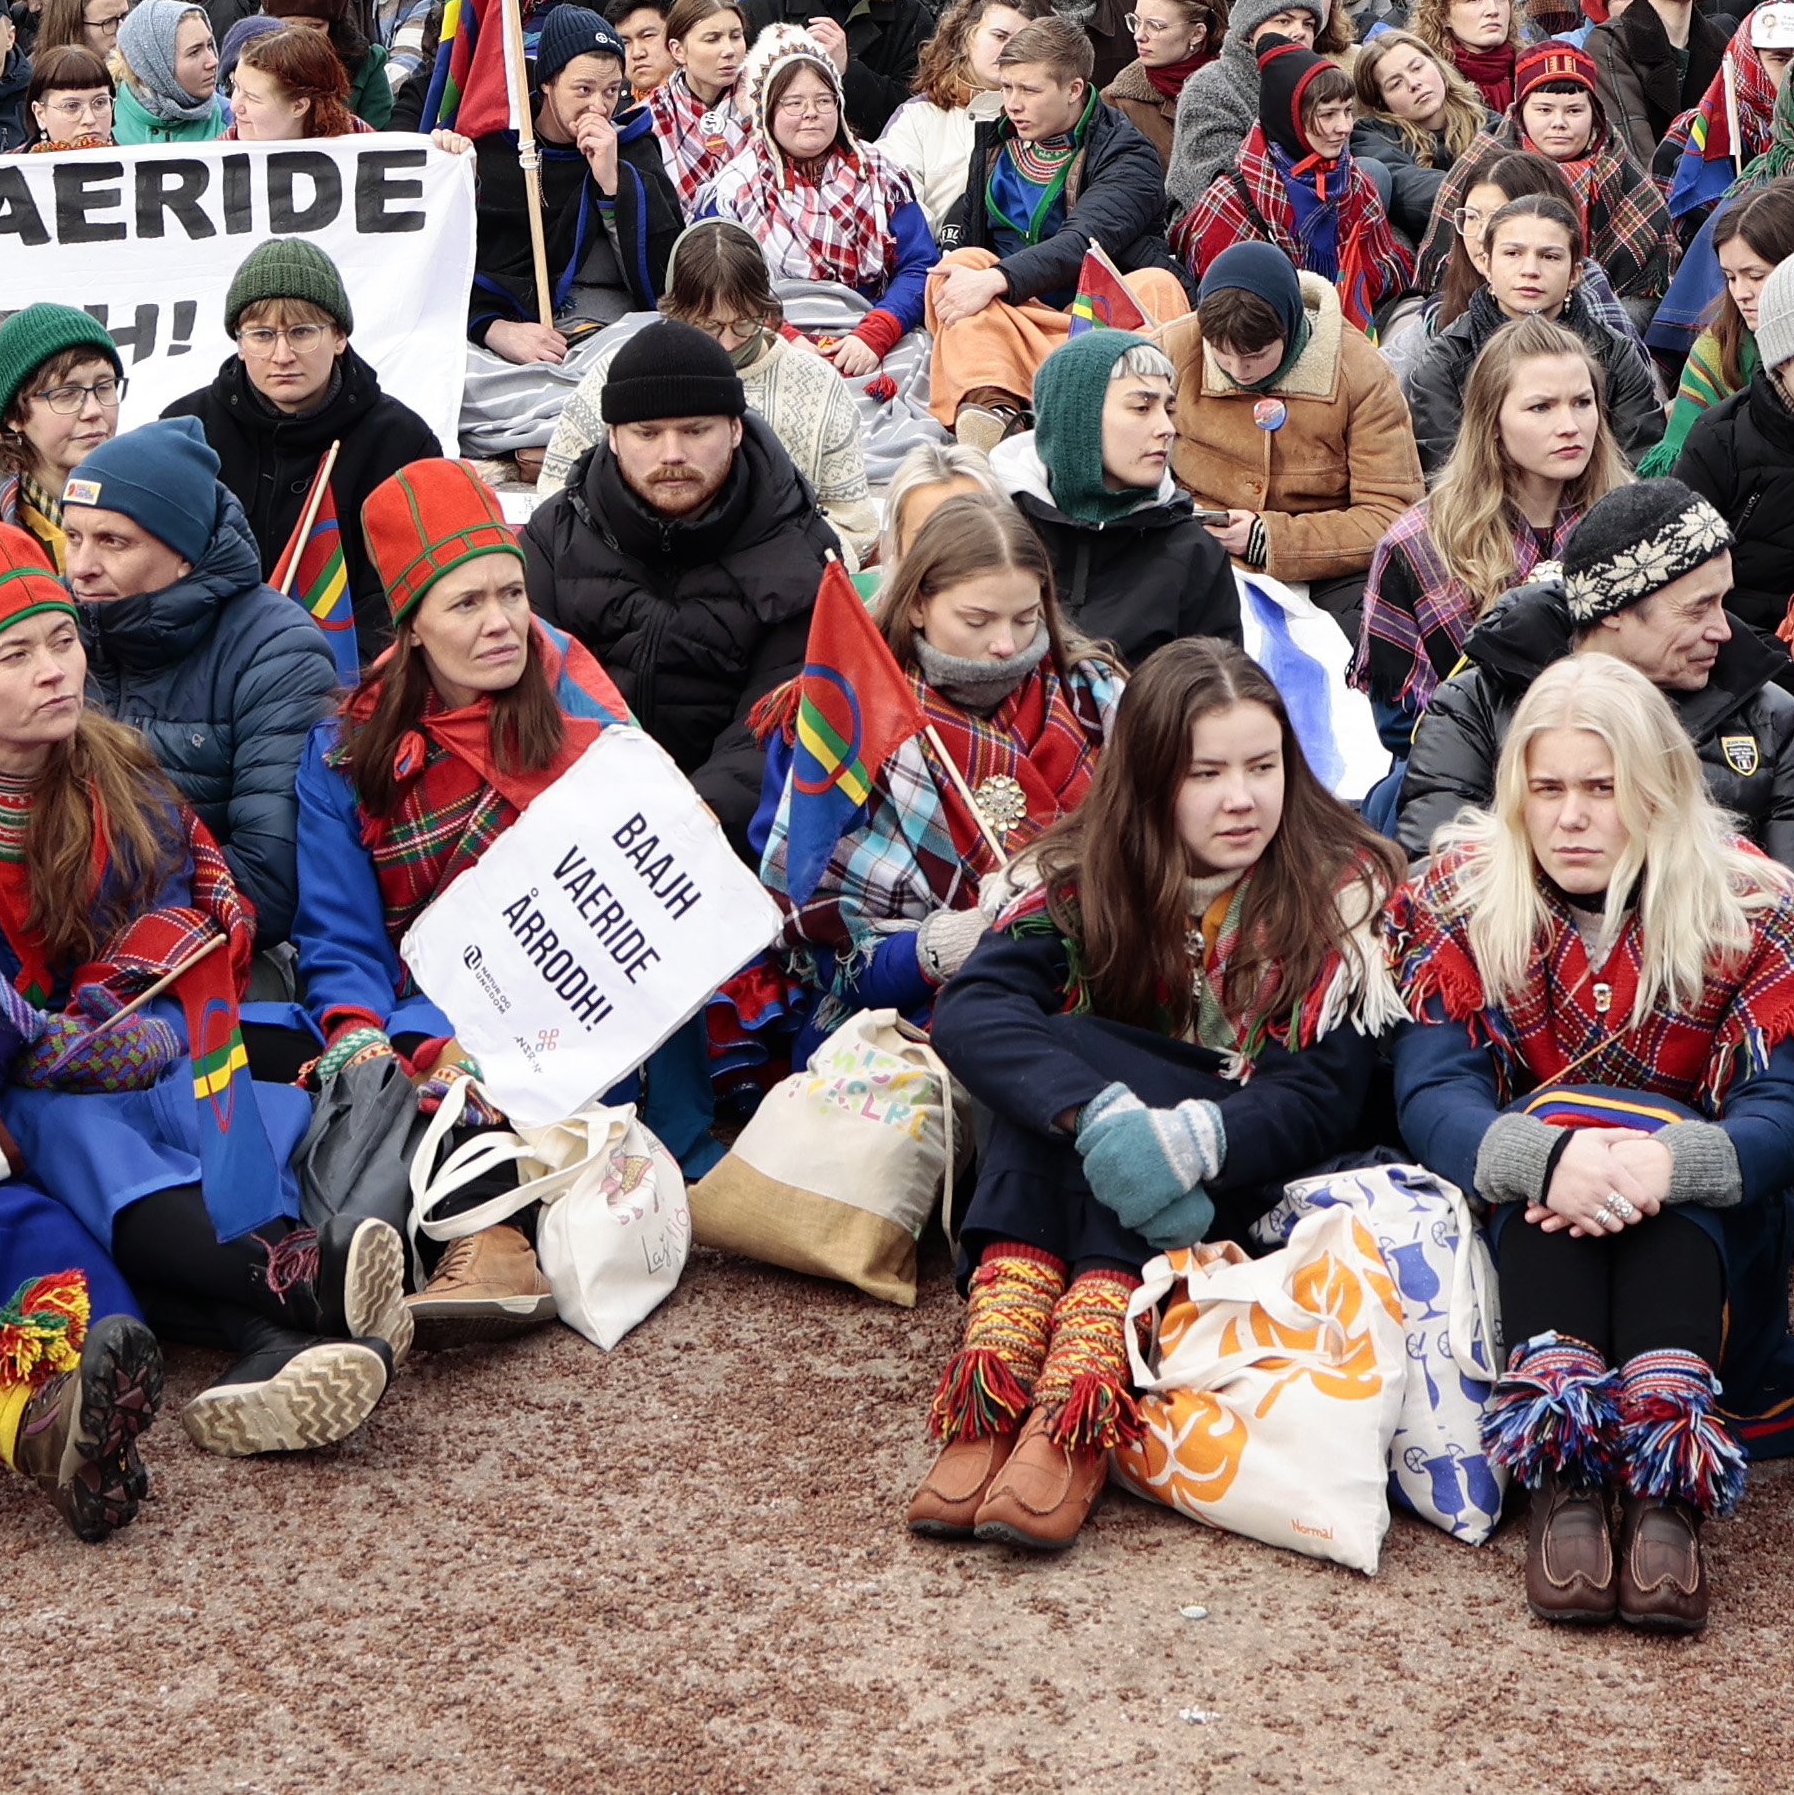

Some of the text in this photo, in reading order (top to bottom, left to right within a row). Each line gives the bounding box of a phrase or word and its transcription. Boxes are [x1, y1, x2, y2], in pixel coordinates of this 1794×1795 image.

[611, 811, 702, 921] BAAJH
[552, 844, 662, 984] VAERIDE
[475, 972, 506, 1014] UNGDOM
[481, 966, 512, 1010] NATUR OG
[501, 887, 614, 1033] ÅRRODH!
[1291, 1518, 1334, 1541] Normal
